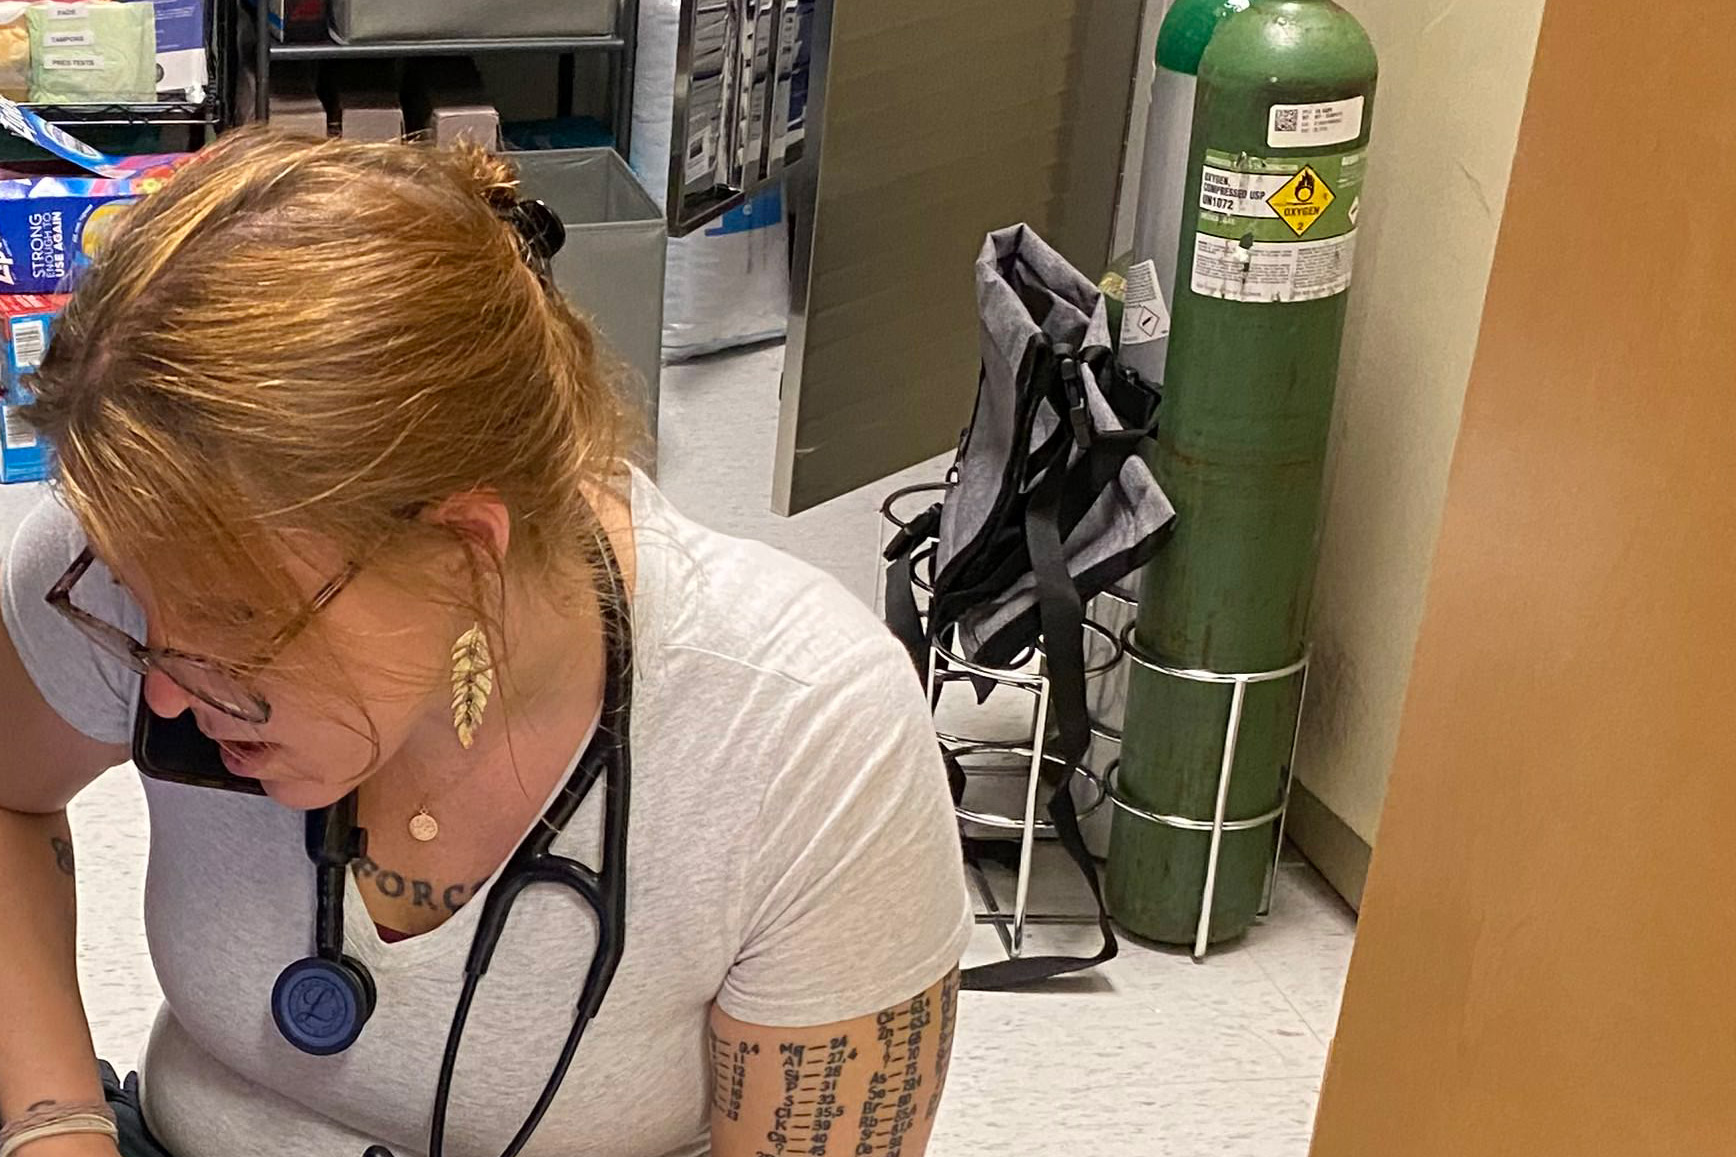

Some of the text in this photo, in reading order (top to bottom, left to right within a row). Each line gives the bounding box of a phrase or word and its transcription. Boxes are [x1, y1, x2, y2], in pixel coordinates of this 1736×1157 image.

[1202, 194, 1234, 210] UN1072
[1204, 182, 1266, 200] COMPRESSED USP
[1284, 206, 1321, 217] OXYGEN
[29, 213, 46, 278] STRONG
[42, 212, 56, 278] ENOUGH TO
[52, 211, 65, 278] USE AGAIN
[351, 855, 490, 913] FORC
